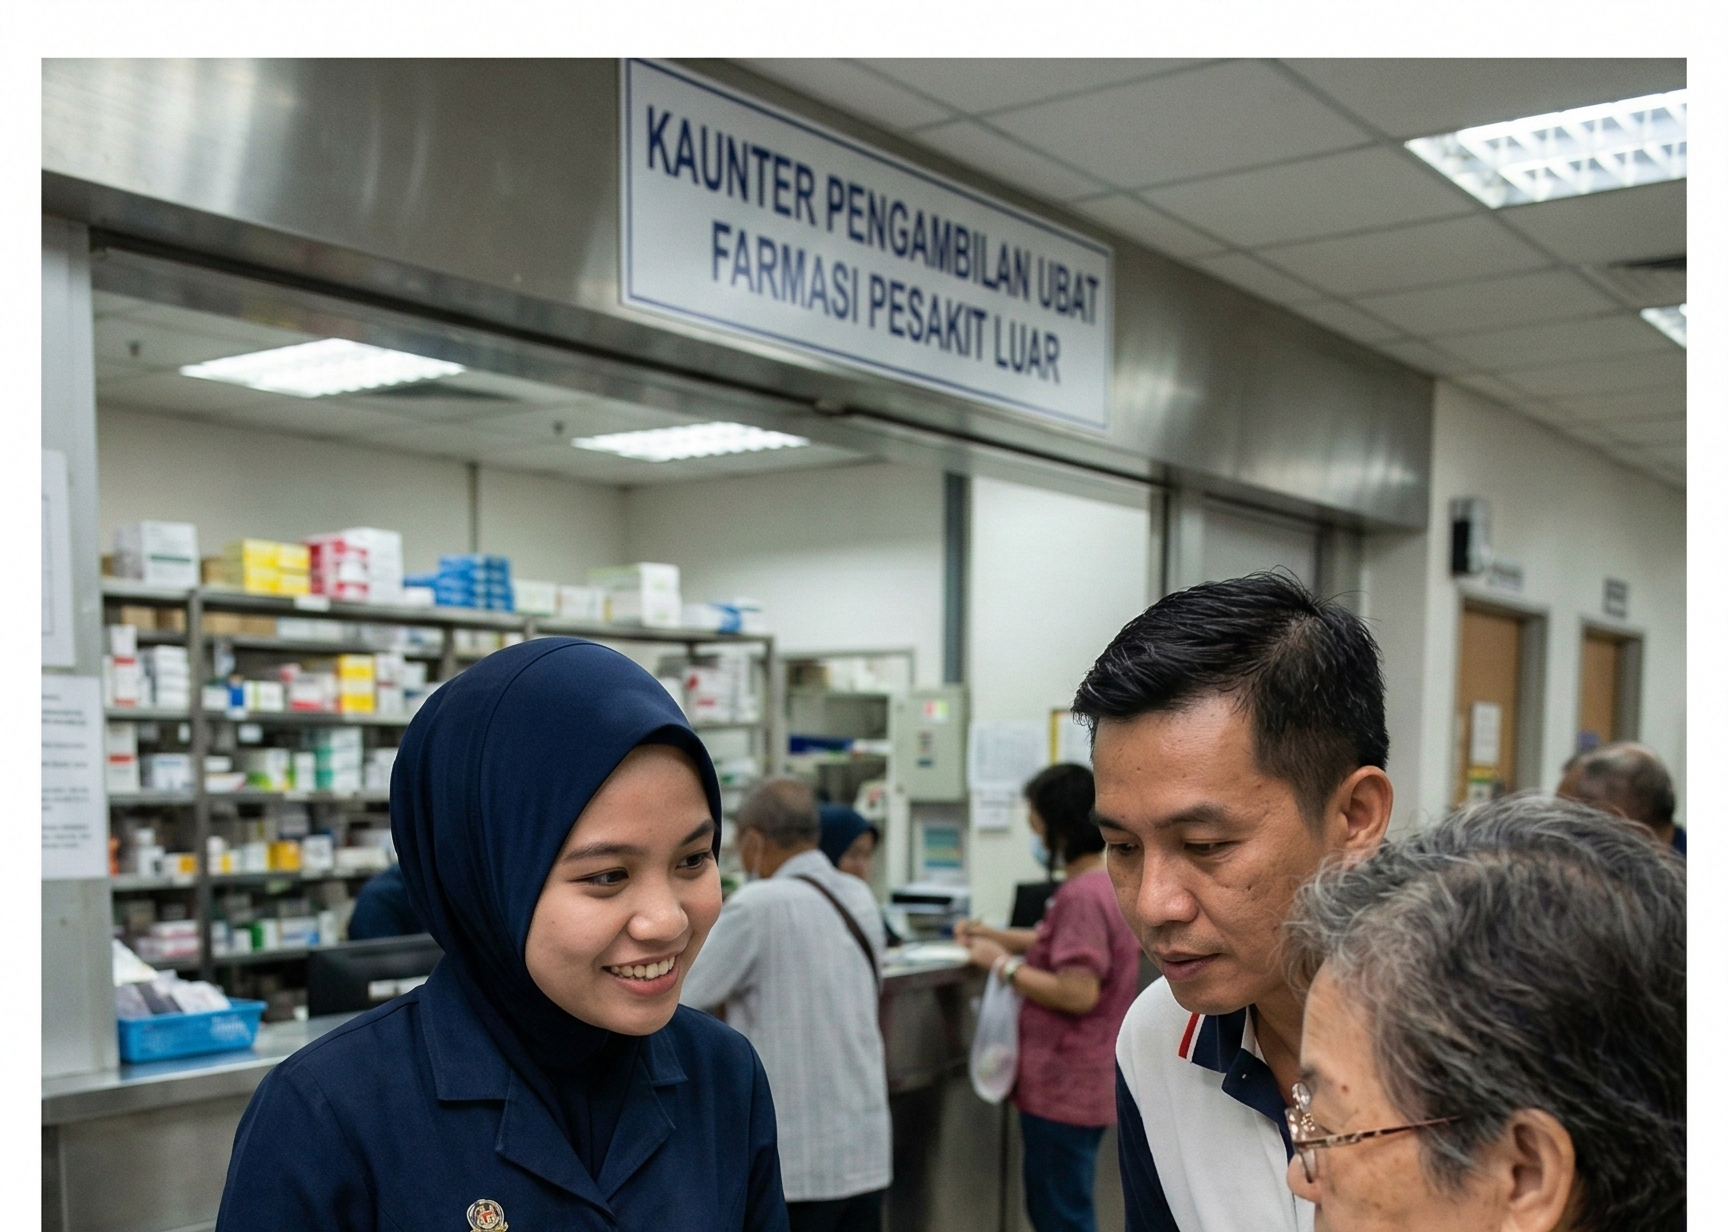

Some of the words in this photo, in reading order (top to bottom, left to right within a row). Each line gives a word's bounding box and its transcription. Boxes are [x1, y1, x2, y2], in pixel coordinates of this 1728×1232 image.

[646, 104, 818, 227] KAUNTER
[825, 174, 1032, 302] PENGAMBILAN
[1036, 255, 1100, 326] UBAT
[710, 218, 859, 324] FARMASI
[867, 272, 987, 362] PESAKIT
[993, 313, 1060, 384] LUAR
